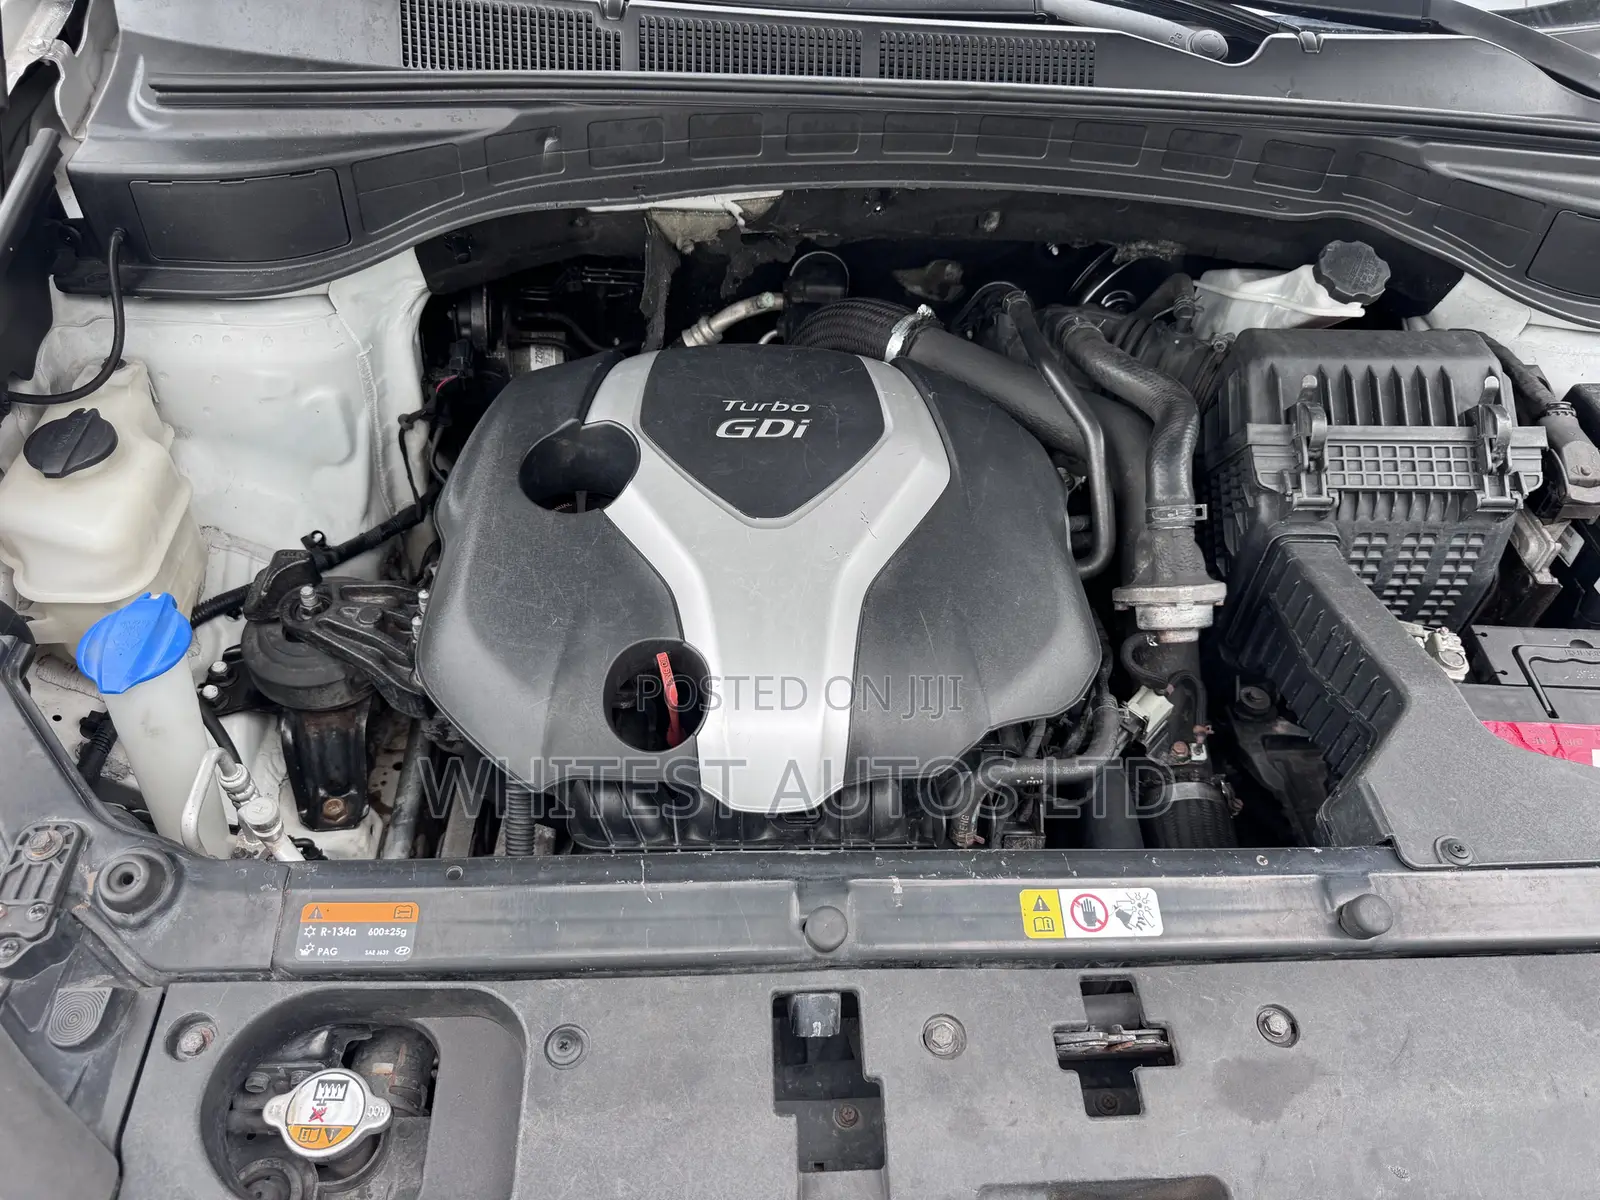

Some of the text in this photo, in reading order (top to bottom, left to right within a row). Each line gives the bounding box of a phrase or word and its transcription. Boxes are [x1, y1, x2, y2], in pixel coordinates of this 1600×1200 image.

[722, 400, 811, 412] Turbo
[715, 418, 813, 438] GDi
[320, 927, 407, 938] R-134a 600±25g
[317, 947, 338, 956] PAG
